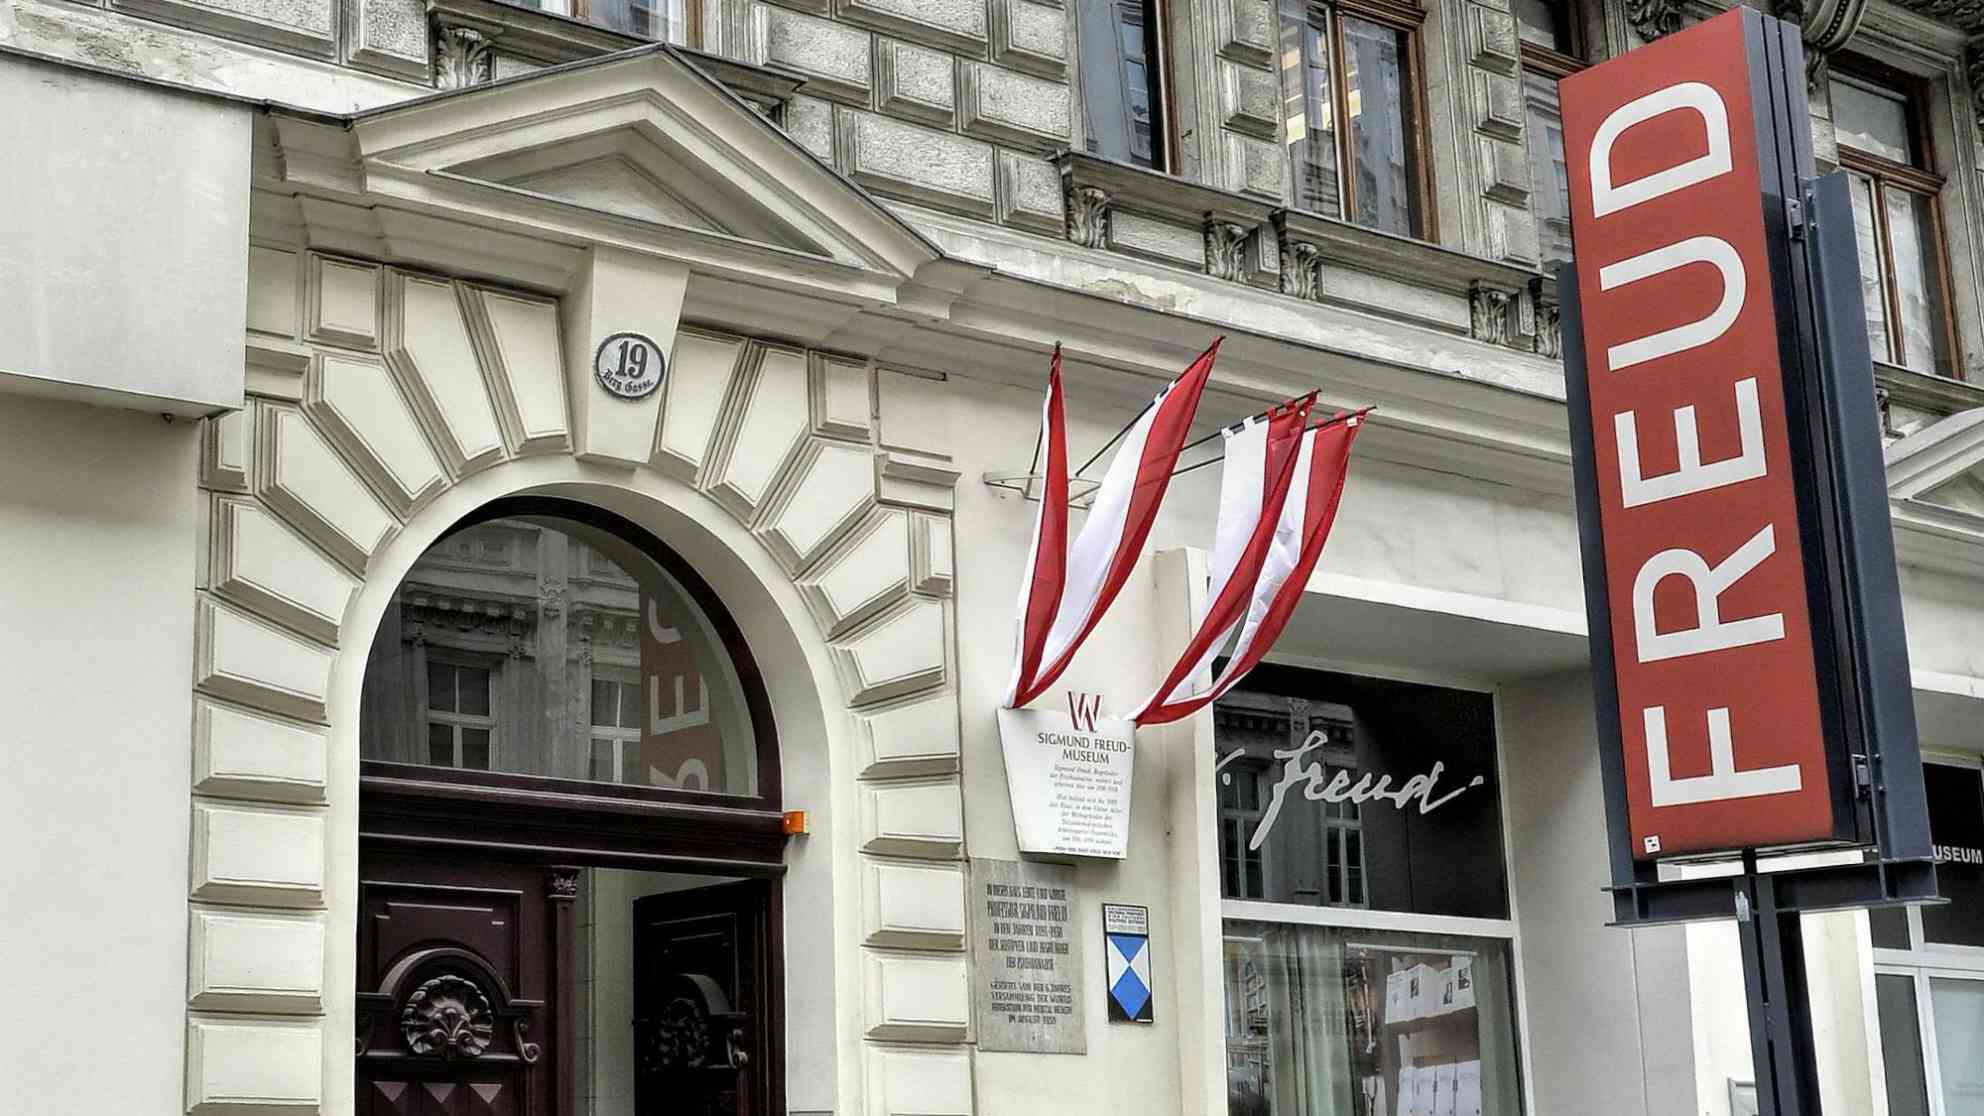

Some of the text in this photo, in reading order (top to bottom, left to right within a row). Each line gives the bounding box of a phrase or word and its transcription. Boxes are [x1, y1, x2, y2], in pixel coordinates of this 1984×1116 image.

[615, 340, 648, 379] 19
[1589, 81, 1802, 808] FREUD
[1038, 732, 1090, 749] SIGMUND
[1062, 748, 1110, 764] MUSEUM
[1932, 844, 1984, 865] USEUM
